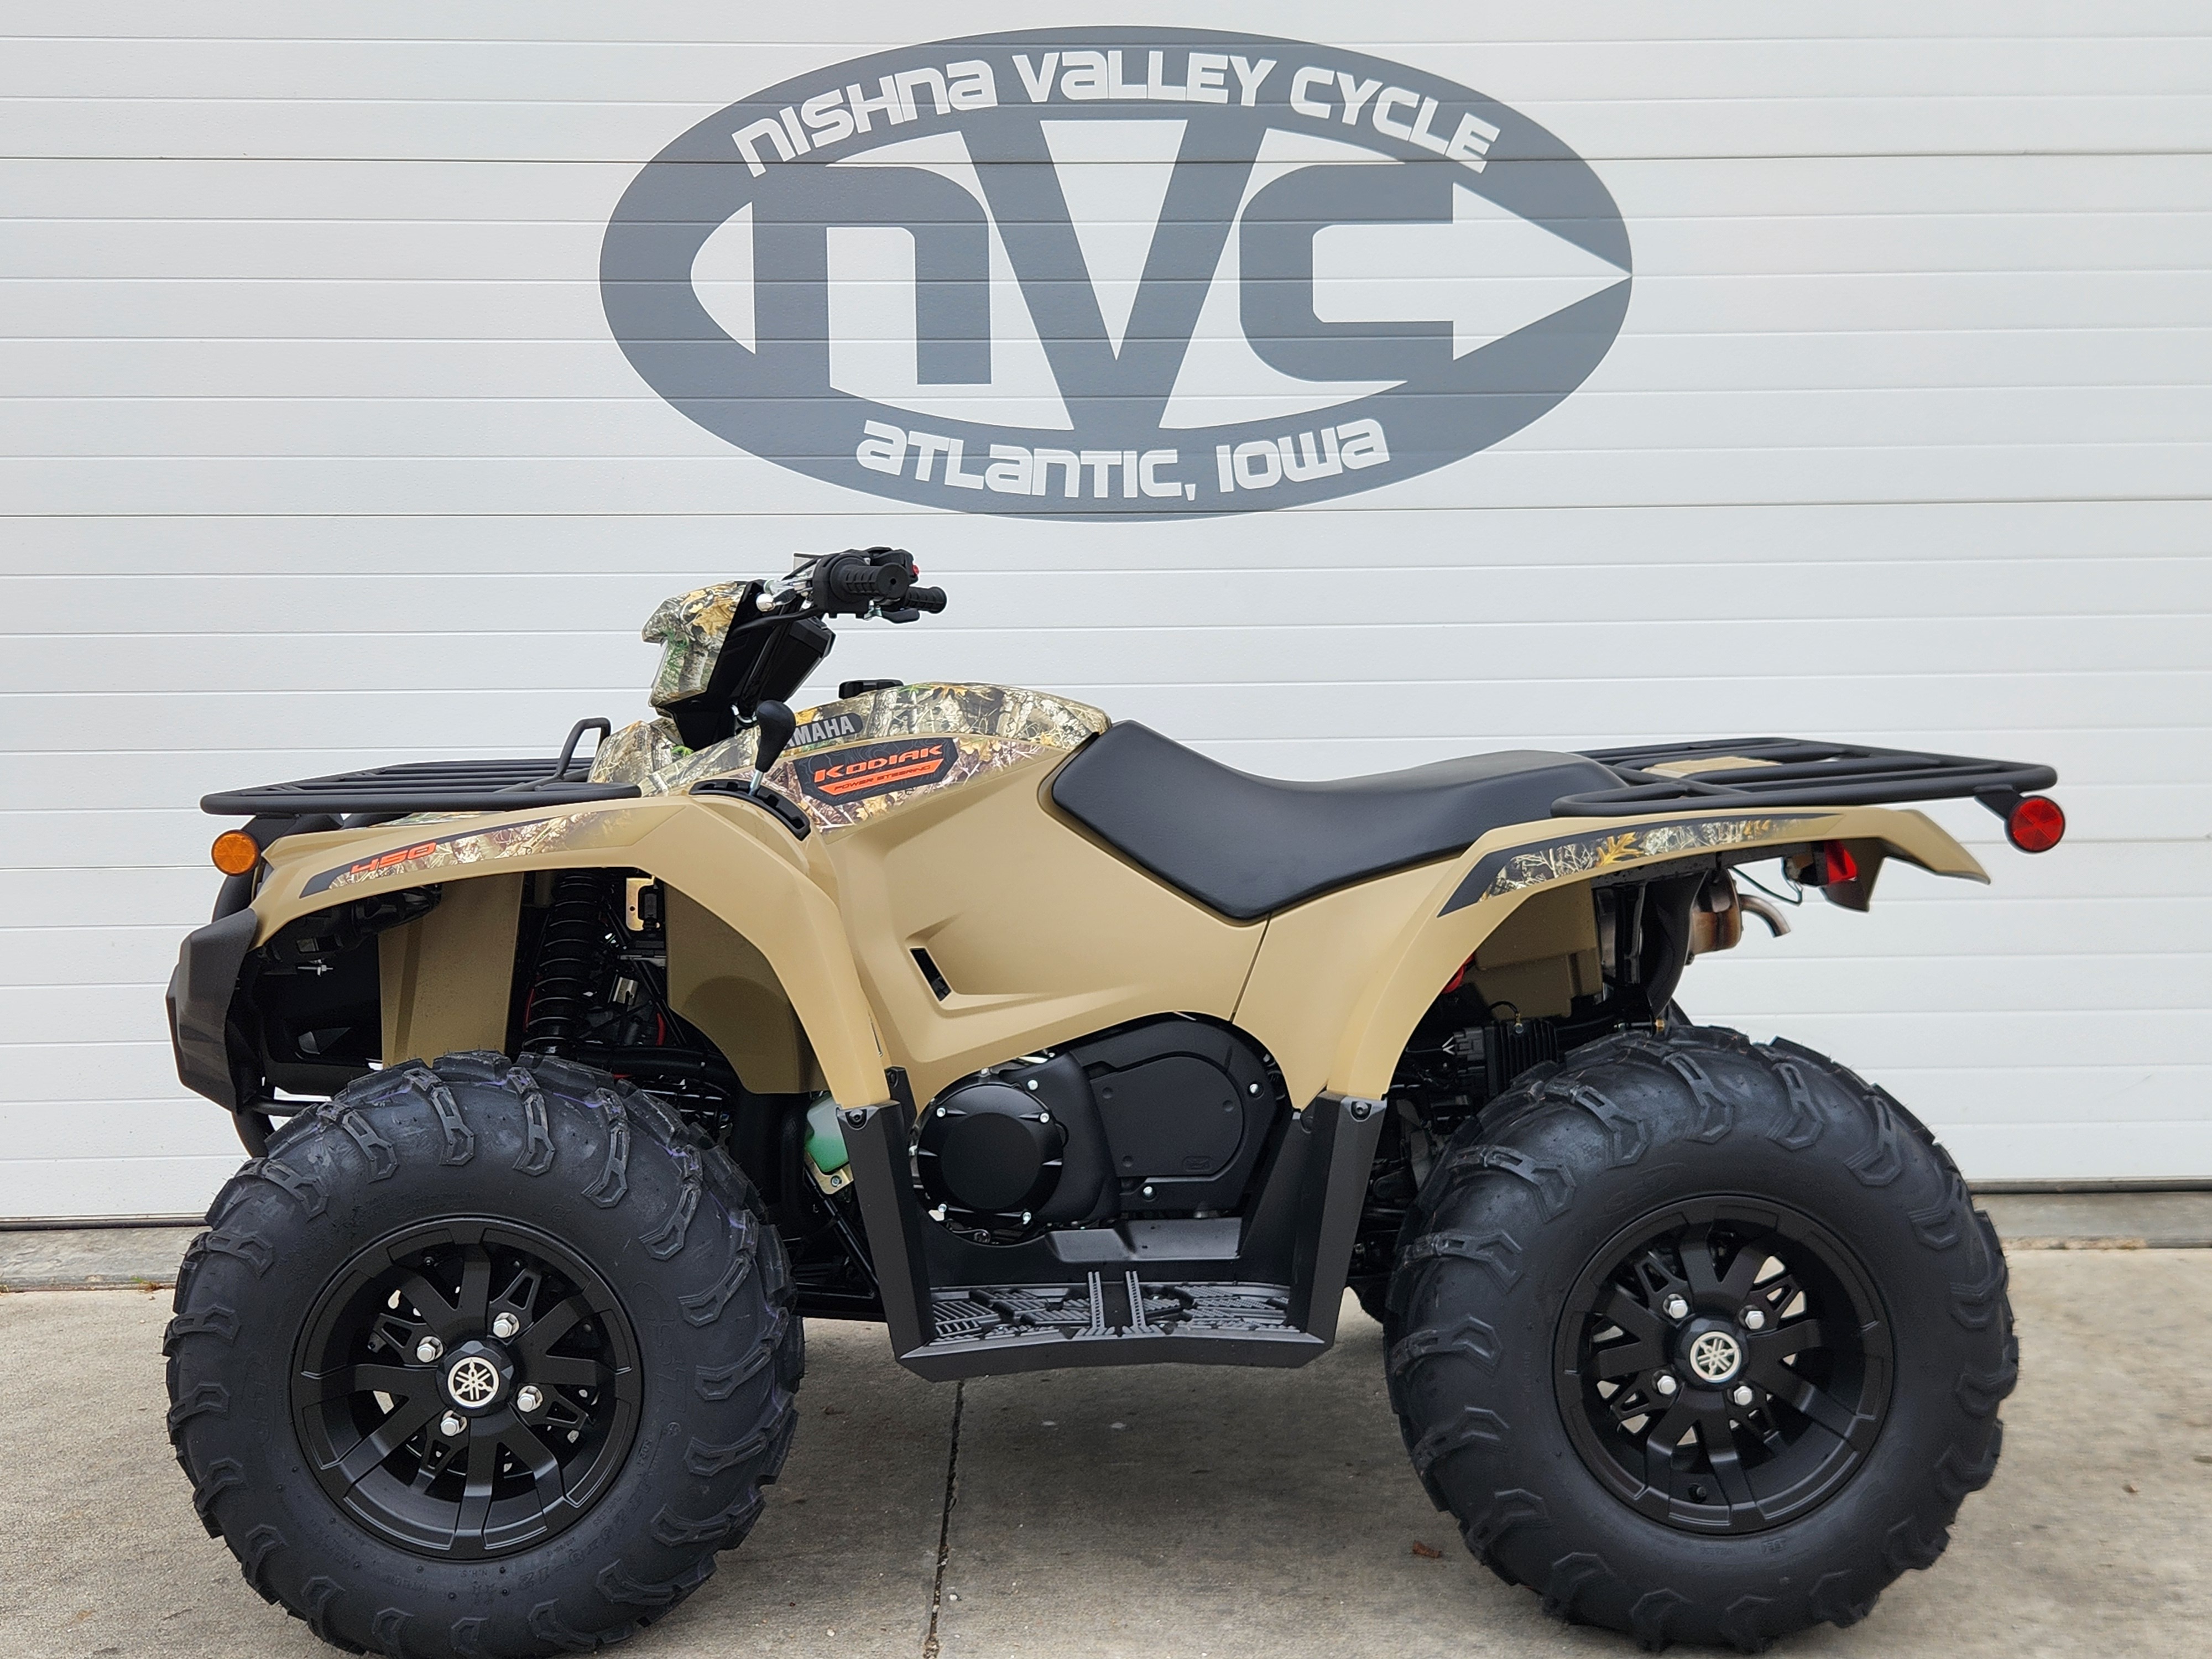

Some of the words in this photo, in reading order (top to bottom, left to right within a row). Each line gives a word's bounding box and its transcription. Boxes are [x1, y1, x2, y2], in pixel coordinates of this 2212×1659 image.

[1290, 66, 1500, 174] CYCLE
[813, 744, 943, 783] KODIAK
[834, 778, 874, 791] POWER
[877, 765, 931, 781] STEERING
[351, 841, 437, 874] 450
